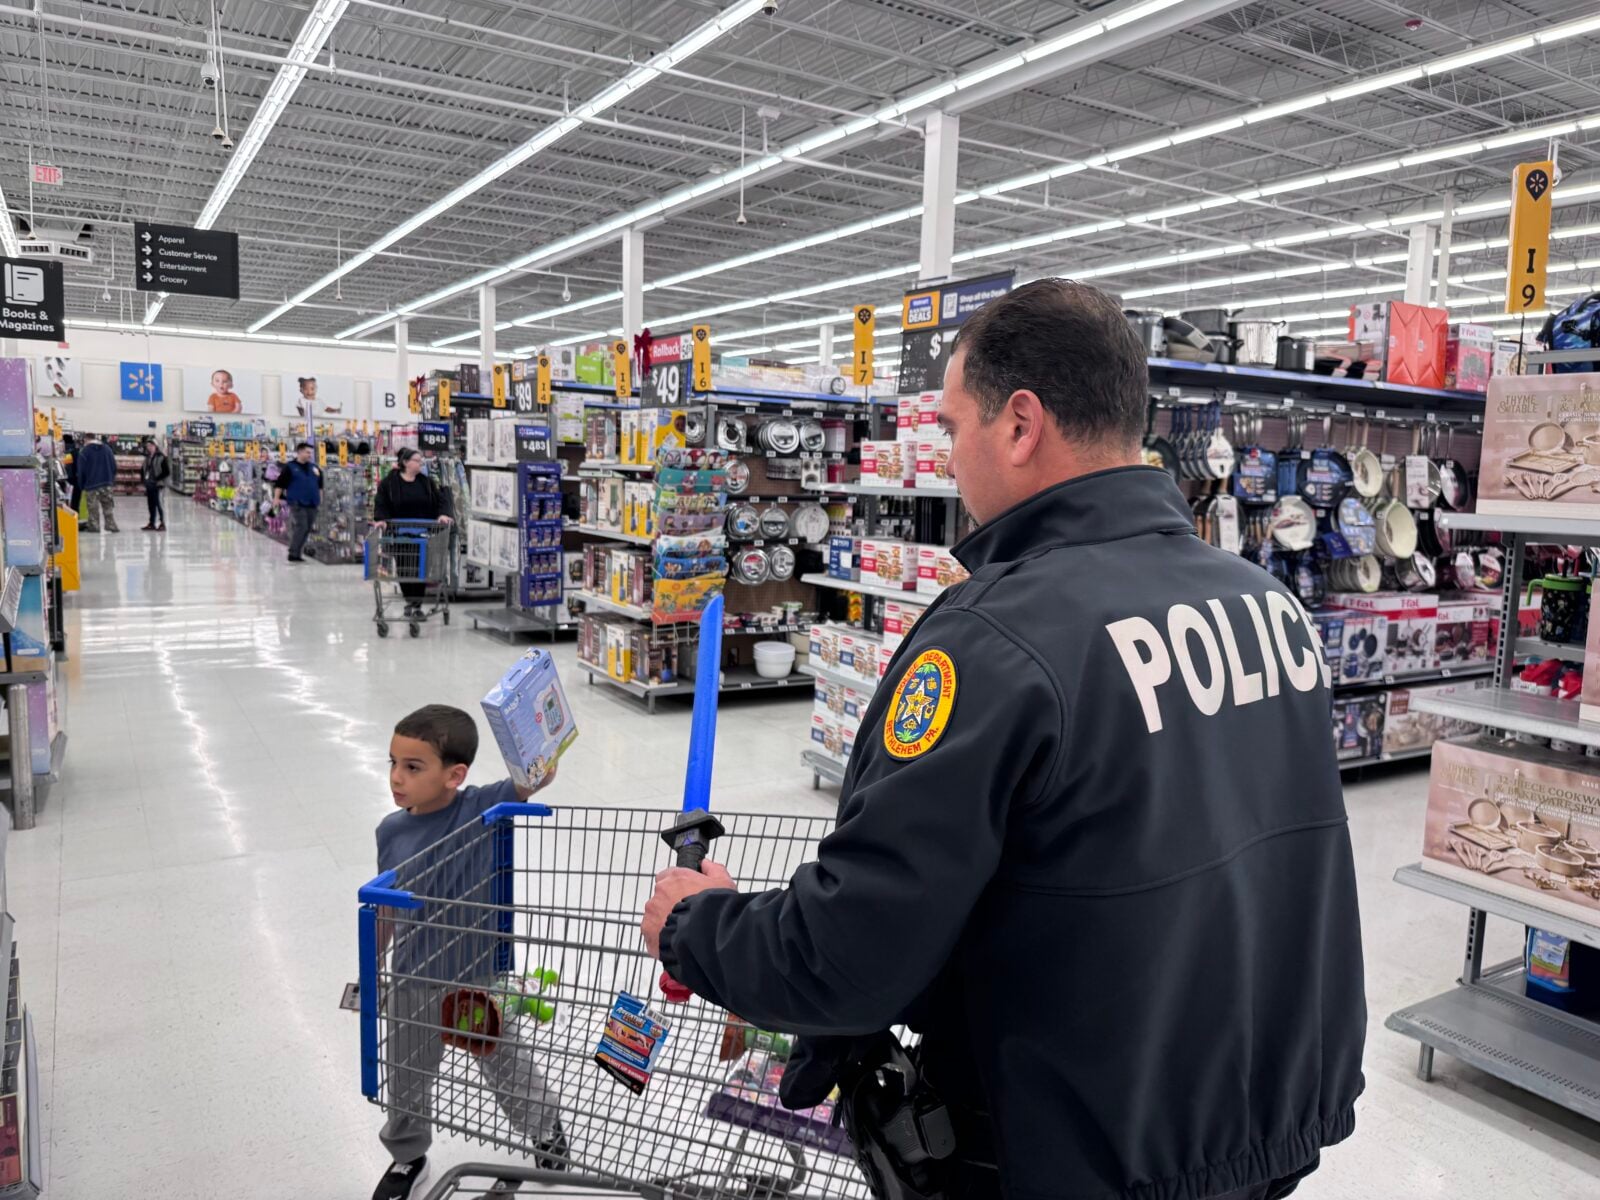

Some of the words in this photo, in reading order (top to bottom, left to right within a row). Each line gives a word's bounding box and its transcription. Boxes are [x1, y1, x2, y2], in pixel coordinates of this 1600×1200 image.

[35, 165, 58, 184] EXIT
[158, 234, 185, 245] Apparel
[158, 247, 193, 259] Customer
[193, 252, 218, 262] Service
[159, 261, 207, 274] Entertainment
[159, 275, 188, 286] Grocery
[2, 307, 37, 320] Books
[39, 310, 49, 321] &
[908, 311, 932, 325] DEALS
[0, 318, 55, 333] Magazines
[653, 343, 681, 357] Rollback
[1505, 394, 1537, 405] THYME
[896, 662, 919, 695] POLICE
[923, 652, 953, 699] DEPARTMENT
[886, 719, 922, 755] BETHLEHEM
[924, 726, 940, 743] PA.
[1572, 803, 1597, 815] SET
